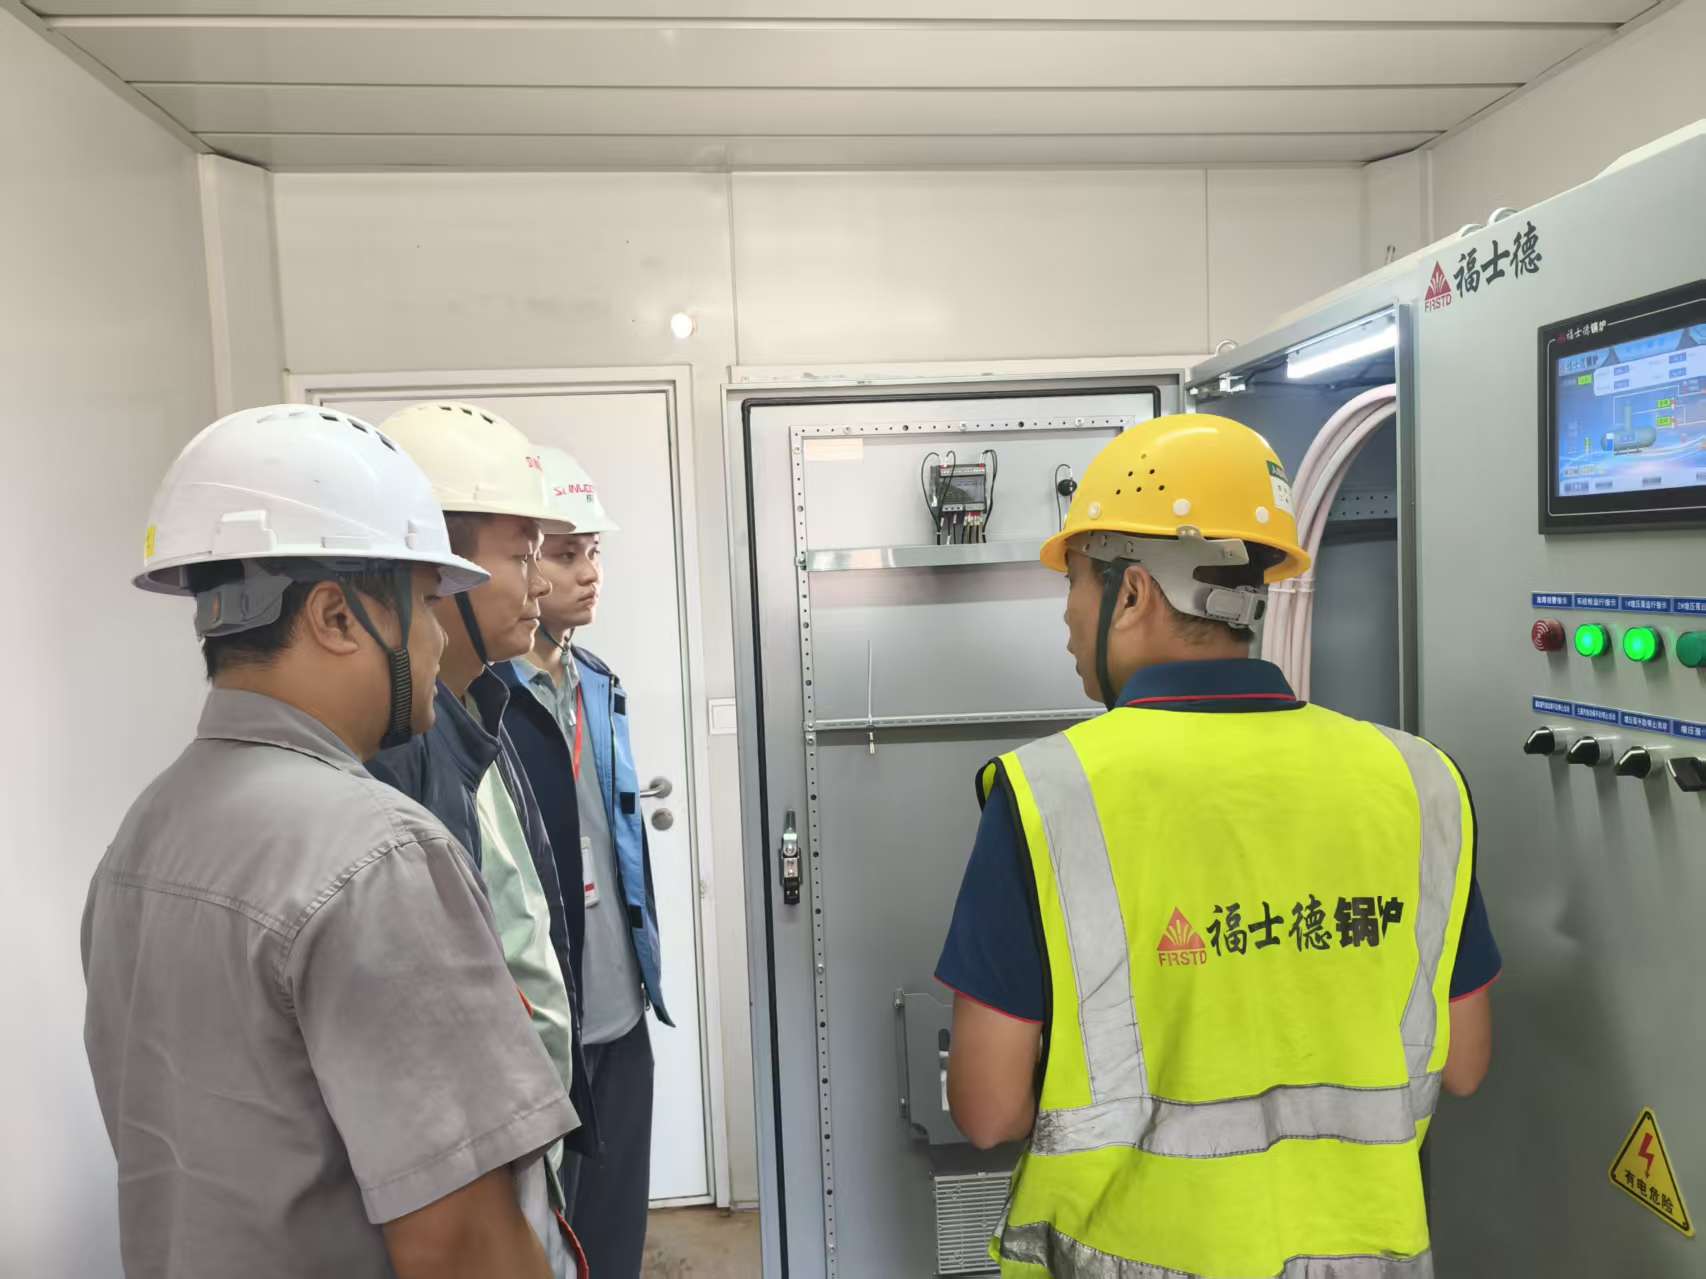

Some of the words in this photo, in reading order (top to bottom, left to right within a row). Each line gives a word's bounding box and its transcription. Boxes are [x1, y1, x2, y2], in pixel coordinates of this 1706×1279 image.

[1453, 221, 1542, 298] 福士德
[1206, 894, 1404, 956] 福士德锅炉
[1158, 950, 1207, 967] FIRSTD
[1625, 1170, 1673, 1215] 有电危险
